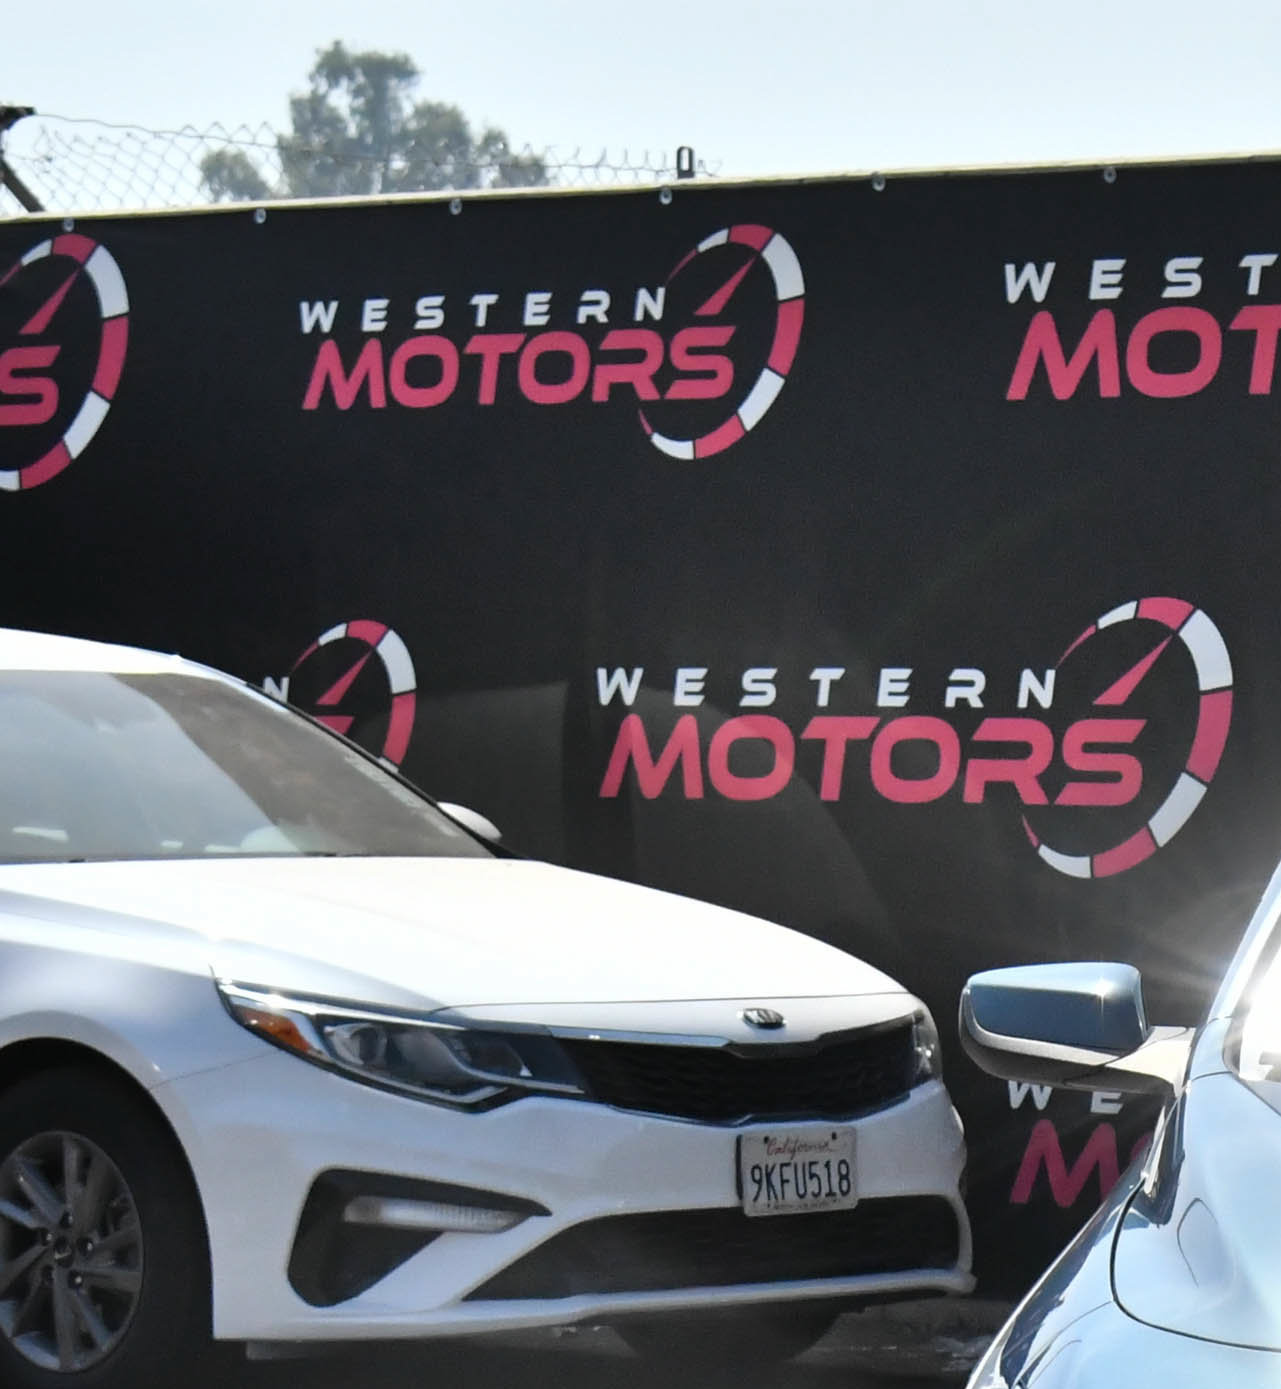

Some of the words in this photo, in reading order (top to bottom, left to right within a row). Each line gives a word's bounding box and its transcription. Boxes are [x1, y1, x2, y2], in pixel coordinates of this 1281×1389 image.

[299, 286, 667, 334] WESTERN
[301, 324, 737, 411] MOTORS
[595, 667, 1058, 709] WESTERN
[599, 714, 1148, 807] MOTORS
[750, 1159, 852, 1203] 9KFU518
